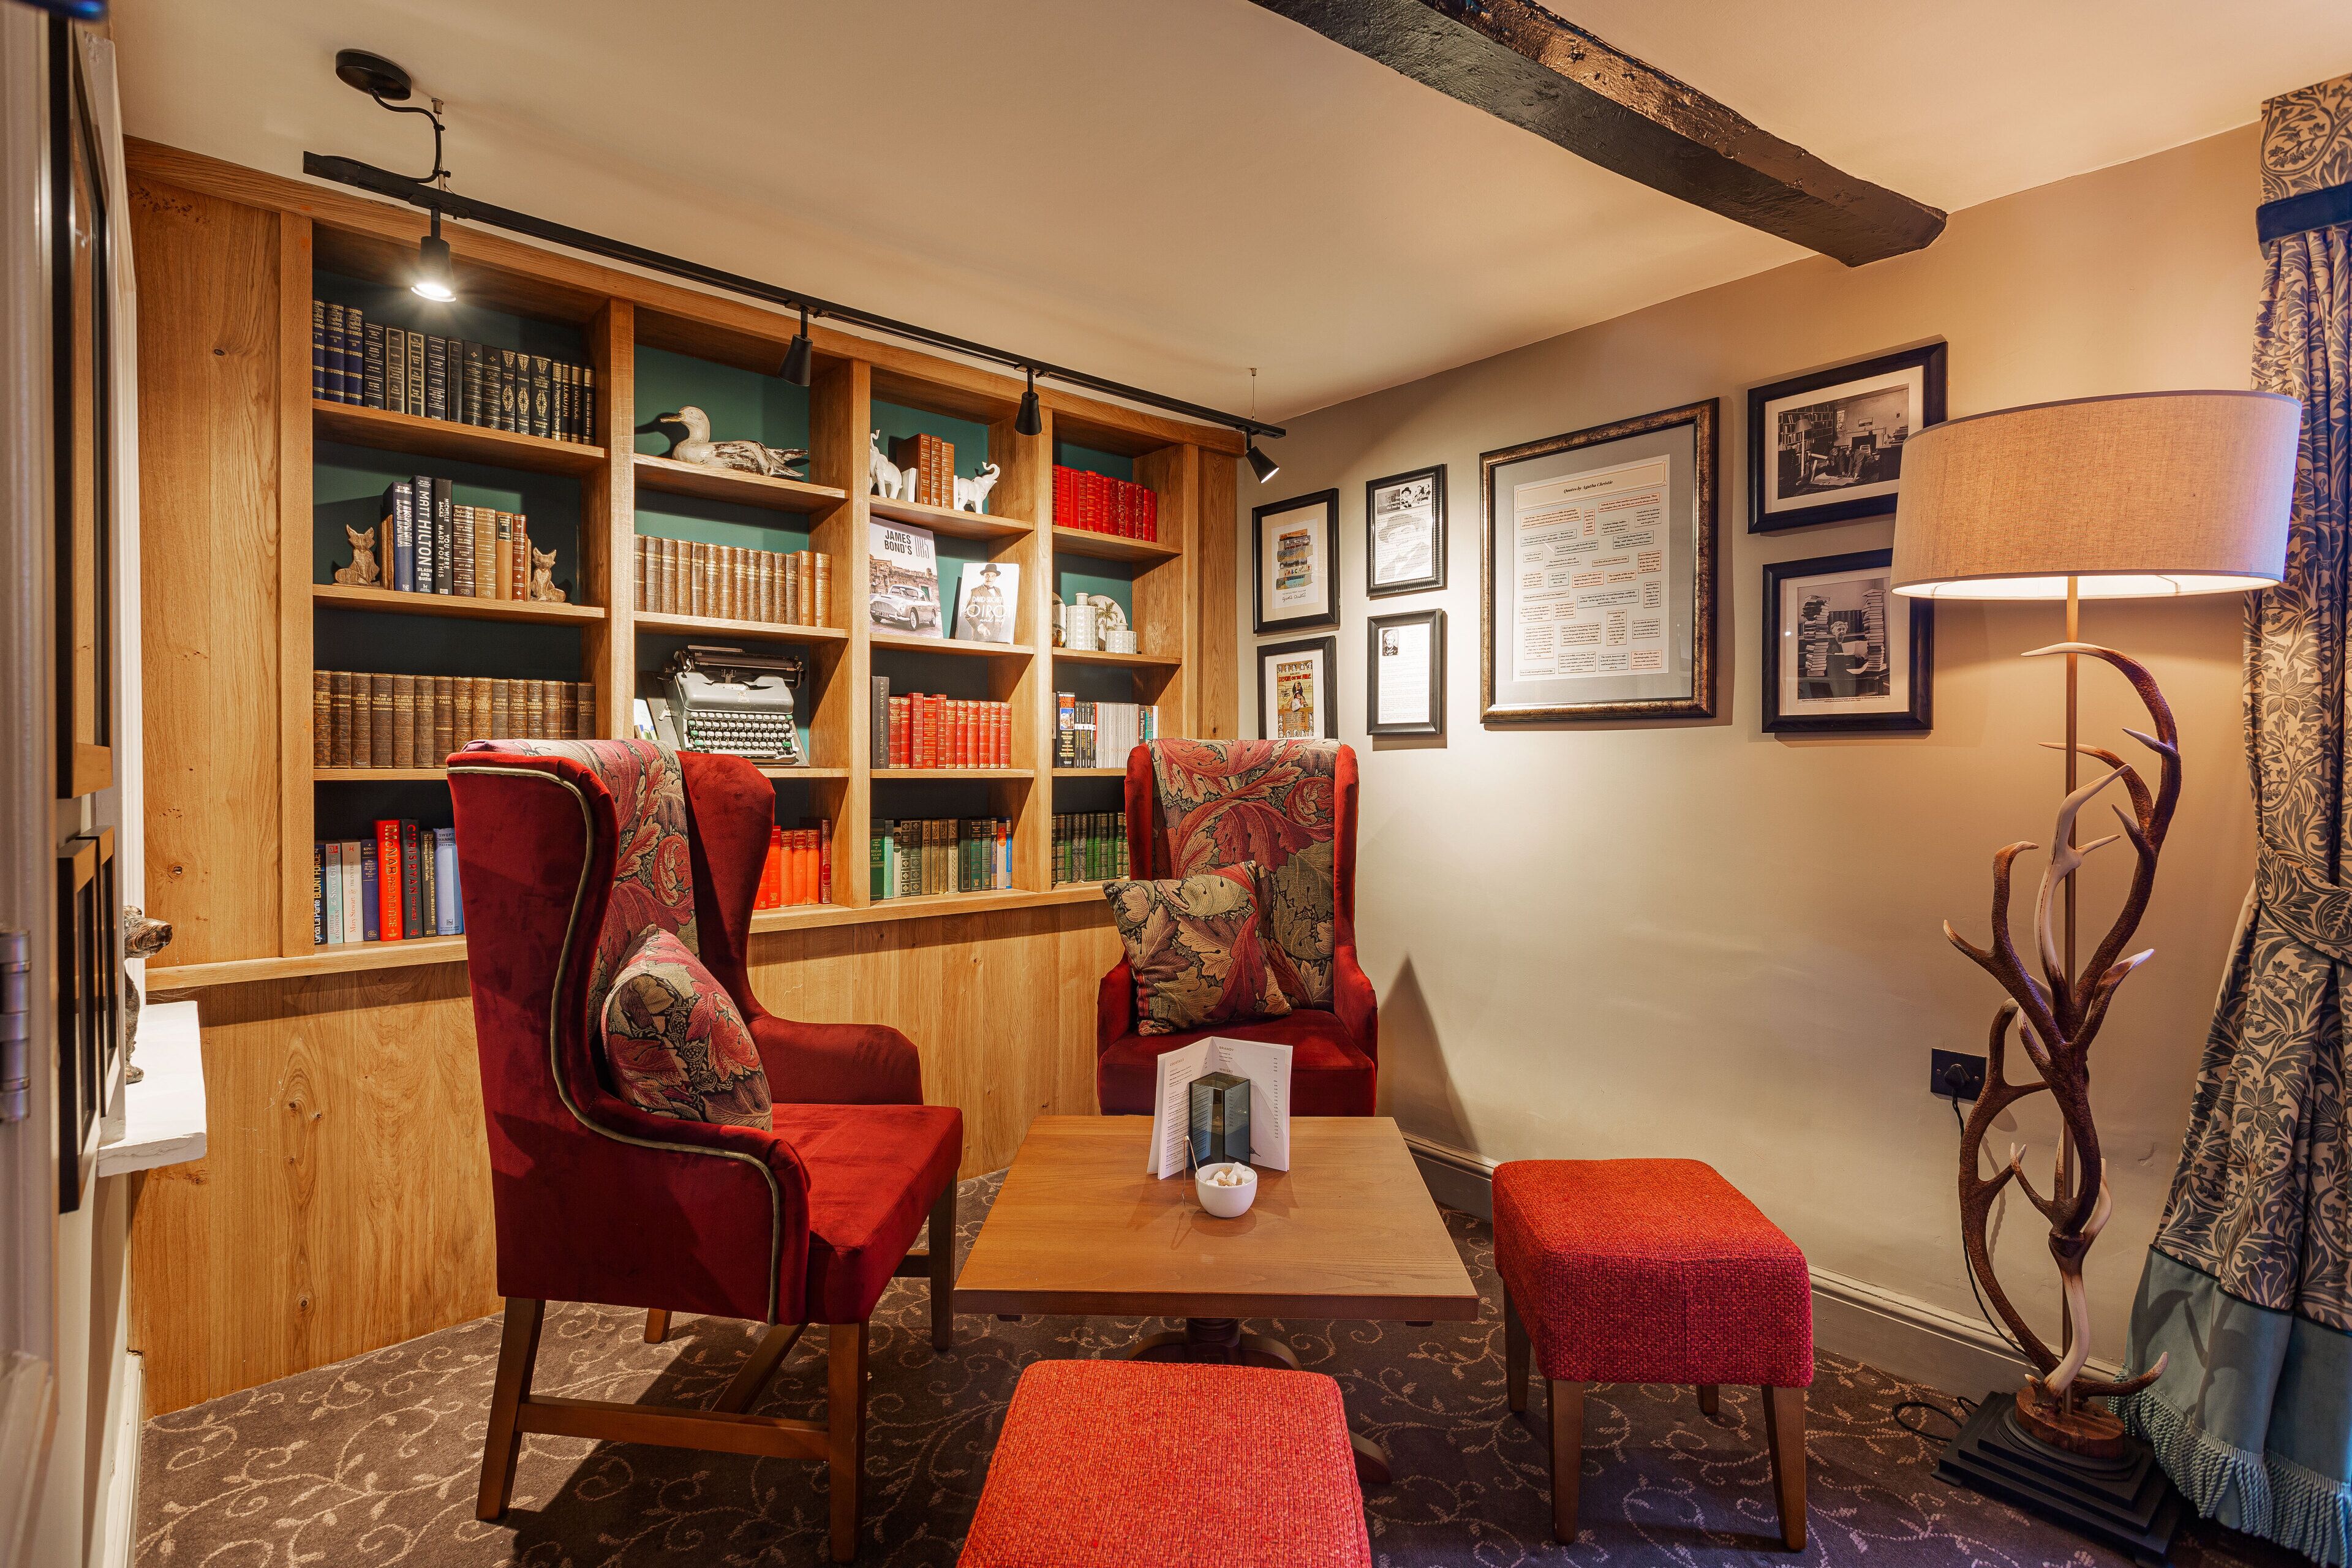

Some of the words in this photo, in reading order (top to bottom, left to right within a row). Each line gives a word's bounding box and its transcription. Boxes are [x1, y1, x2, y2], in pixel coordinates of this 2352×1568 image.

[420, 491, 429, 518] MATT
[396, 499, 412, 547] LUSITANIA
[885, 530, 911, 545] JAMES
[418, 519, 432, 566] HILTON
[884, 540, 913, 556] BOND'S
[914, 536, 930, 559] DB5
[960, 604, 1014, 617] POIROT
[385, 828, 398, 875] McNAB
[407, 824, 417, 861] CHRIS
[387, 876, 397, 893] RED
[408, 864, 418, 895] RYAN
[388, 896, 397, 927] NOTICE
